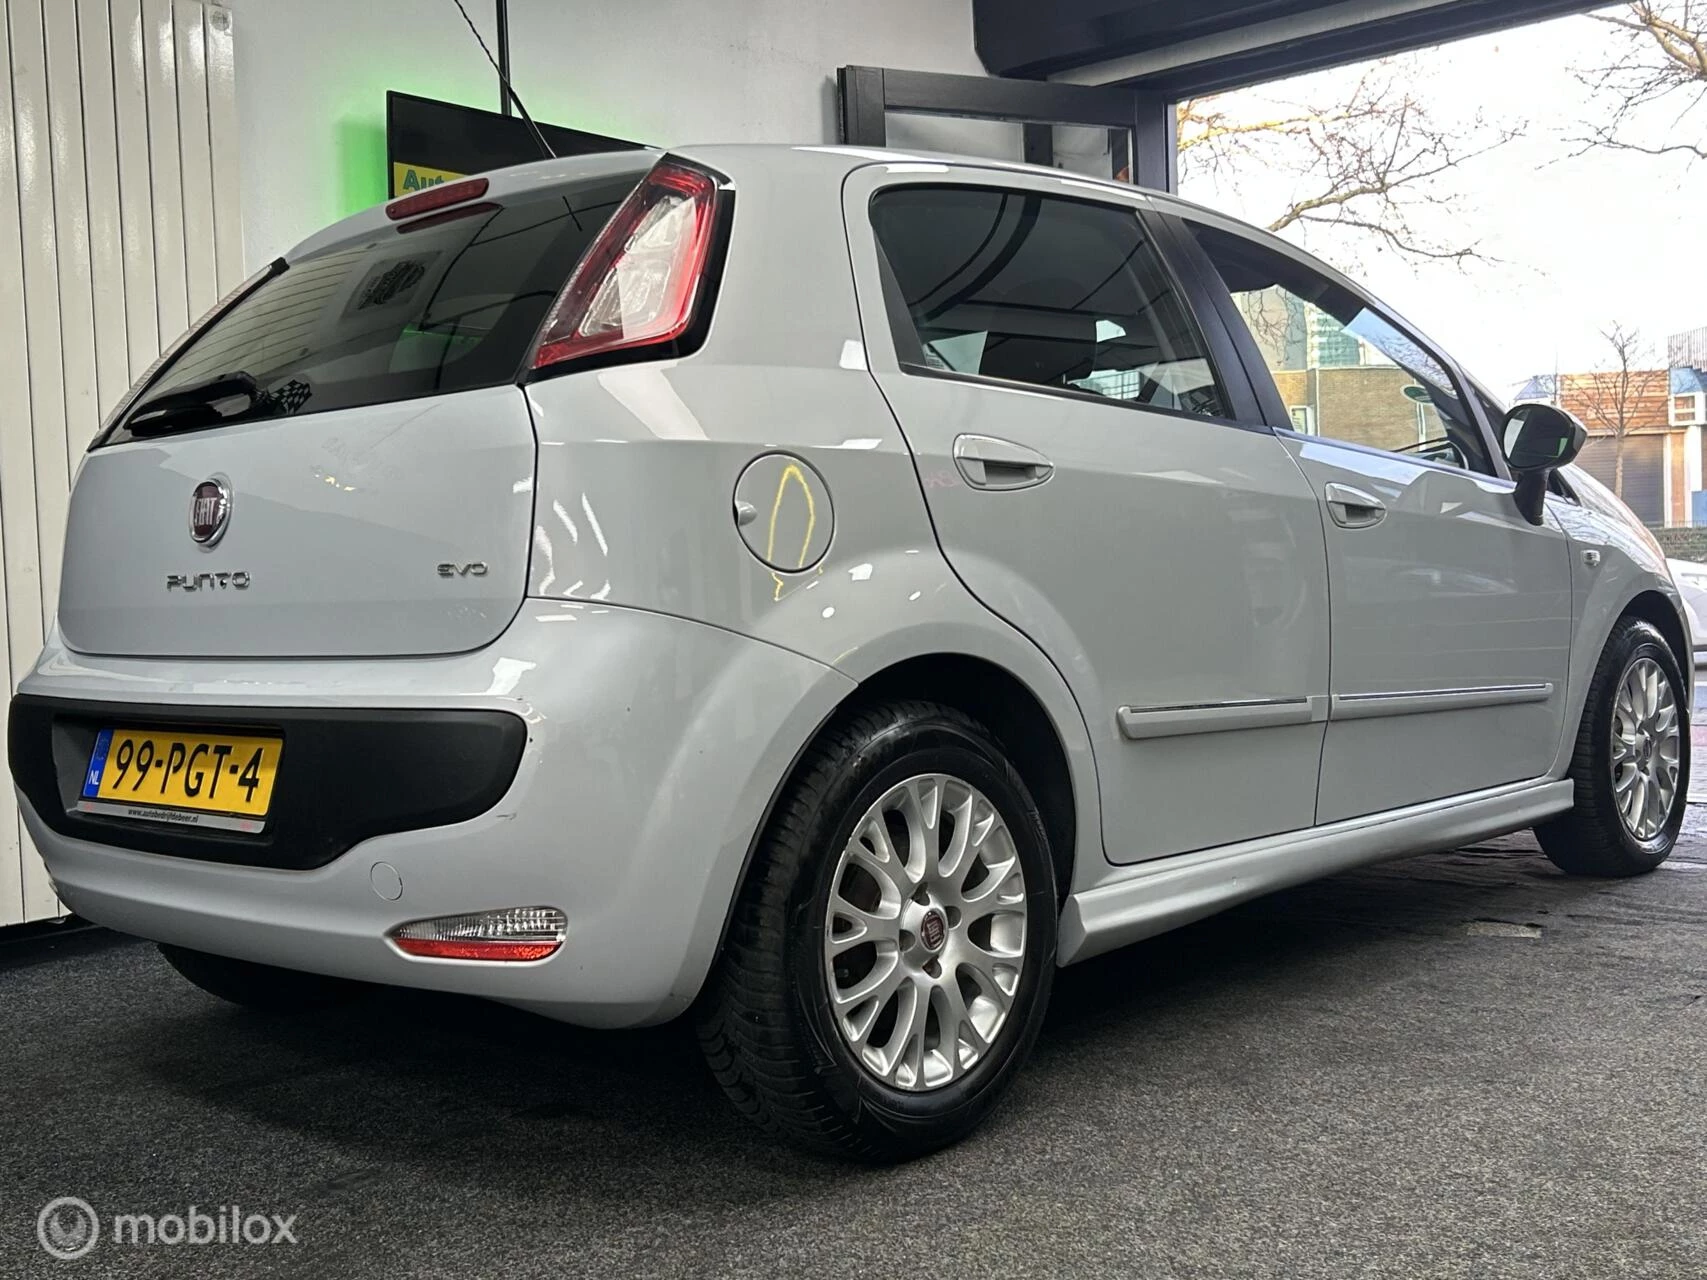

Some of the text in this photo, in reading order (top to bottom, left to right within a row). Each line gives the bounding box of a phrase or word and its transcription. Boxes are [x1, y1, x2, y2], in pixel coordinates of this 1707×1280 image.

[437, 562, 488, 578] EVO
[167, 572, 250, 592] PUNTO
[89, 769, 99, 785] NL
[112, 739, 264, 803] 99-PGT-4
